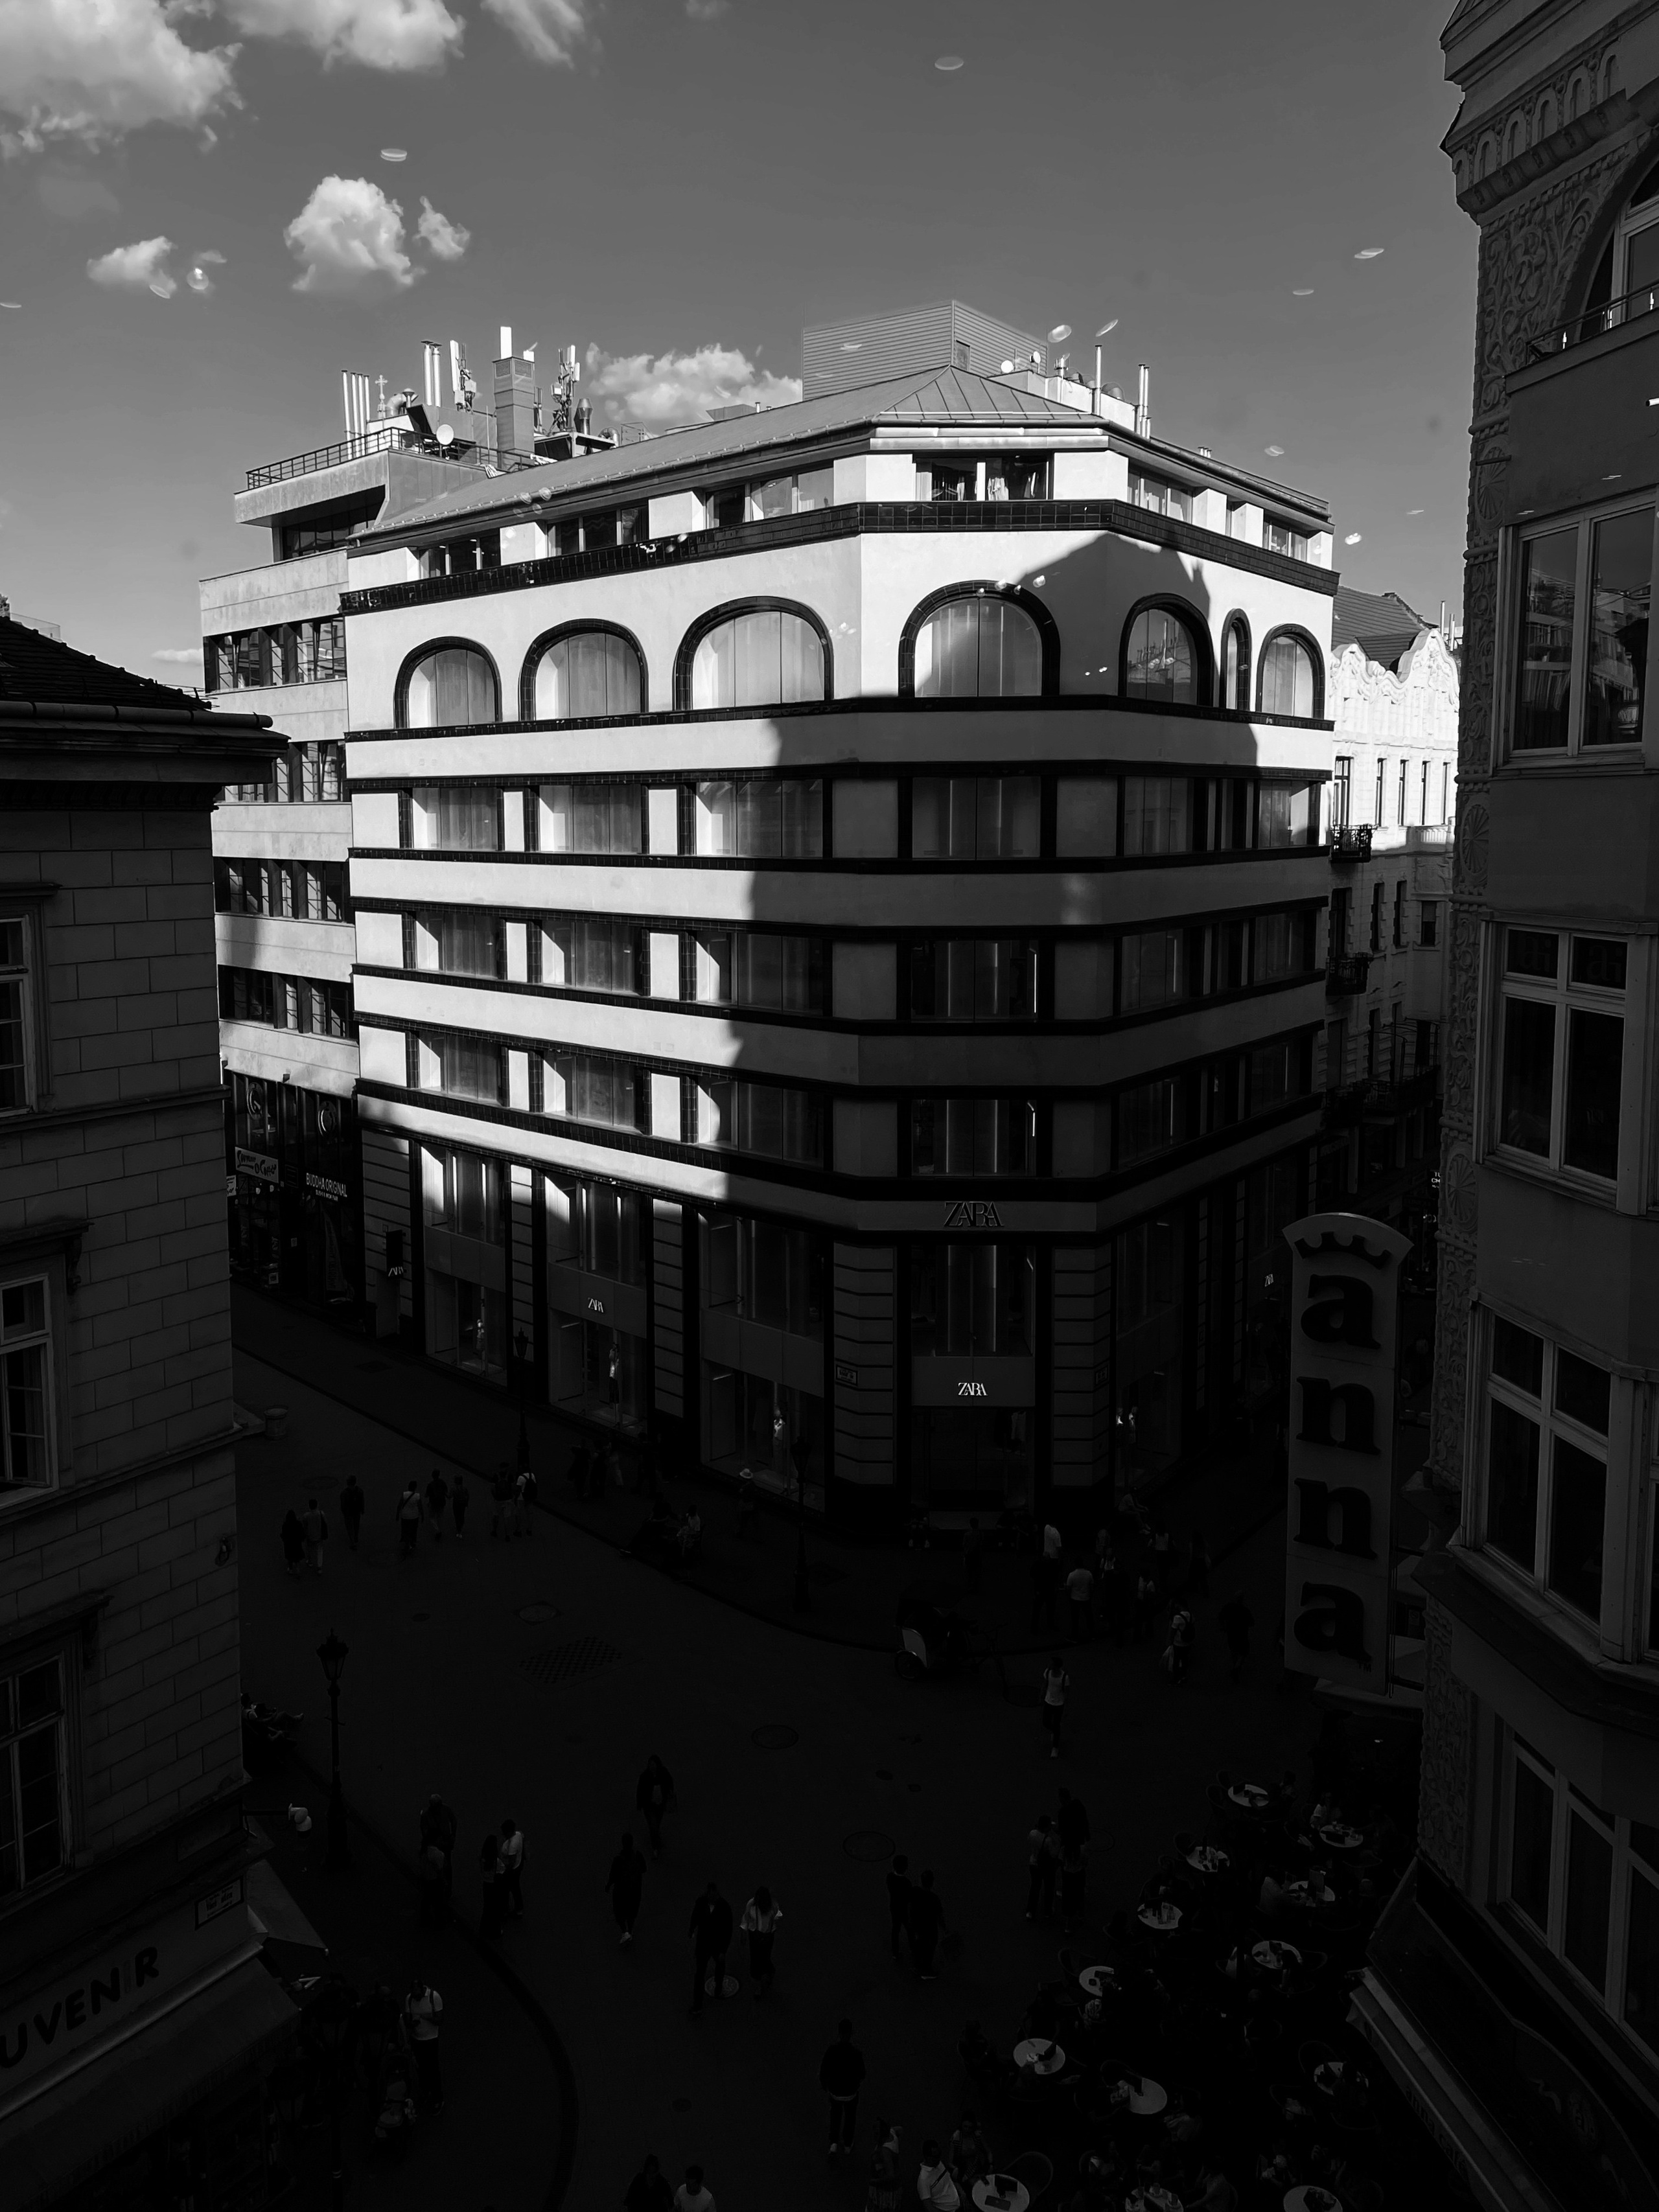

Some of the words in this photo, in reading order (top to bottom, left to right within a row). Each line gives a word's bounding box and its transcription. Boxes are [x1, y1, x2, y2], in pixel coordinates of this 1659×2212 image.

[306, 1172, 325, 1191] BUDDHA
[325, 1178, 348, 1198] ORIGINAL
[944, 1201, 1004, 1228] ZARA
[957, 1381, 989, 1398] ZARA
[1292, 1274, 1381, 1663] anna
